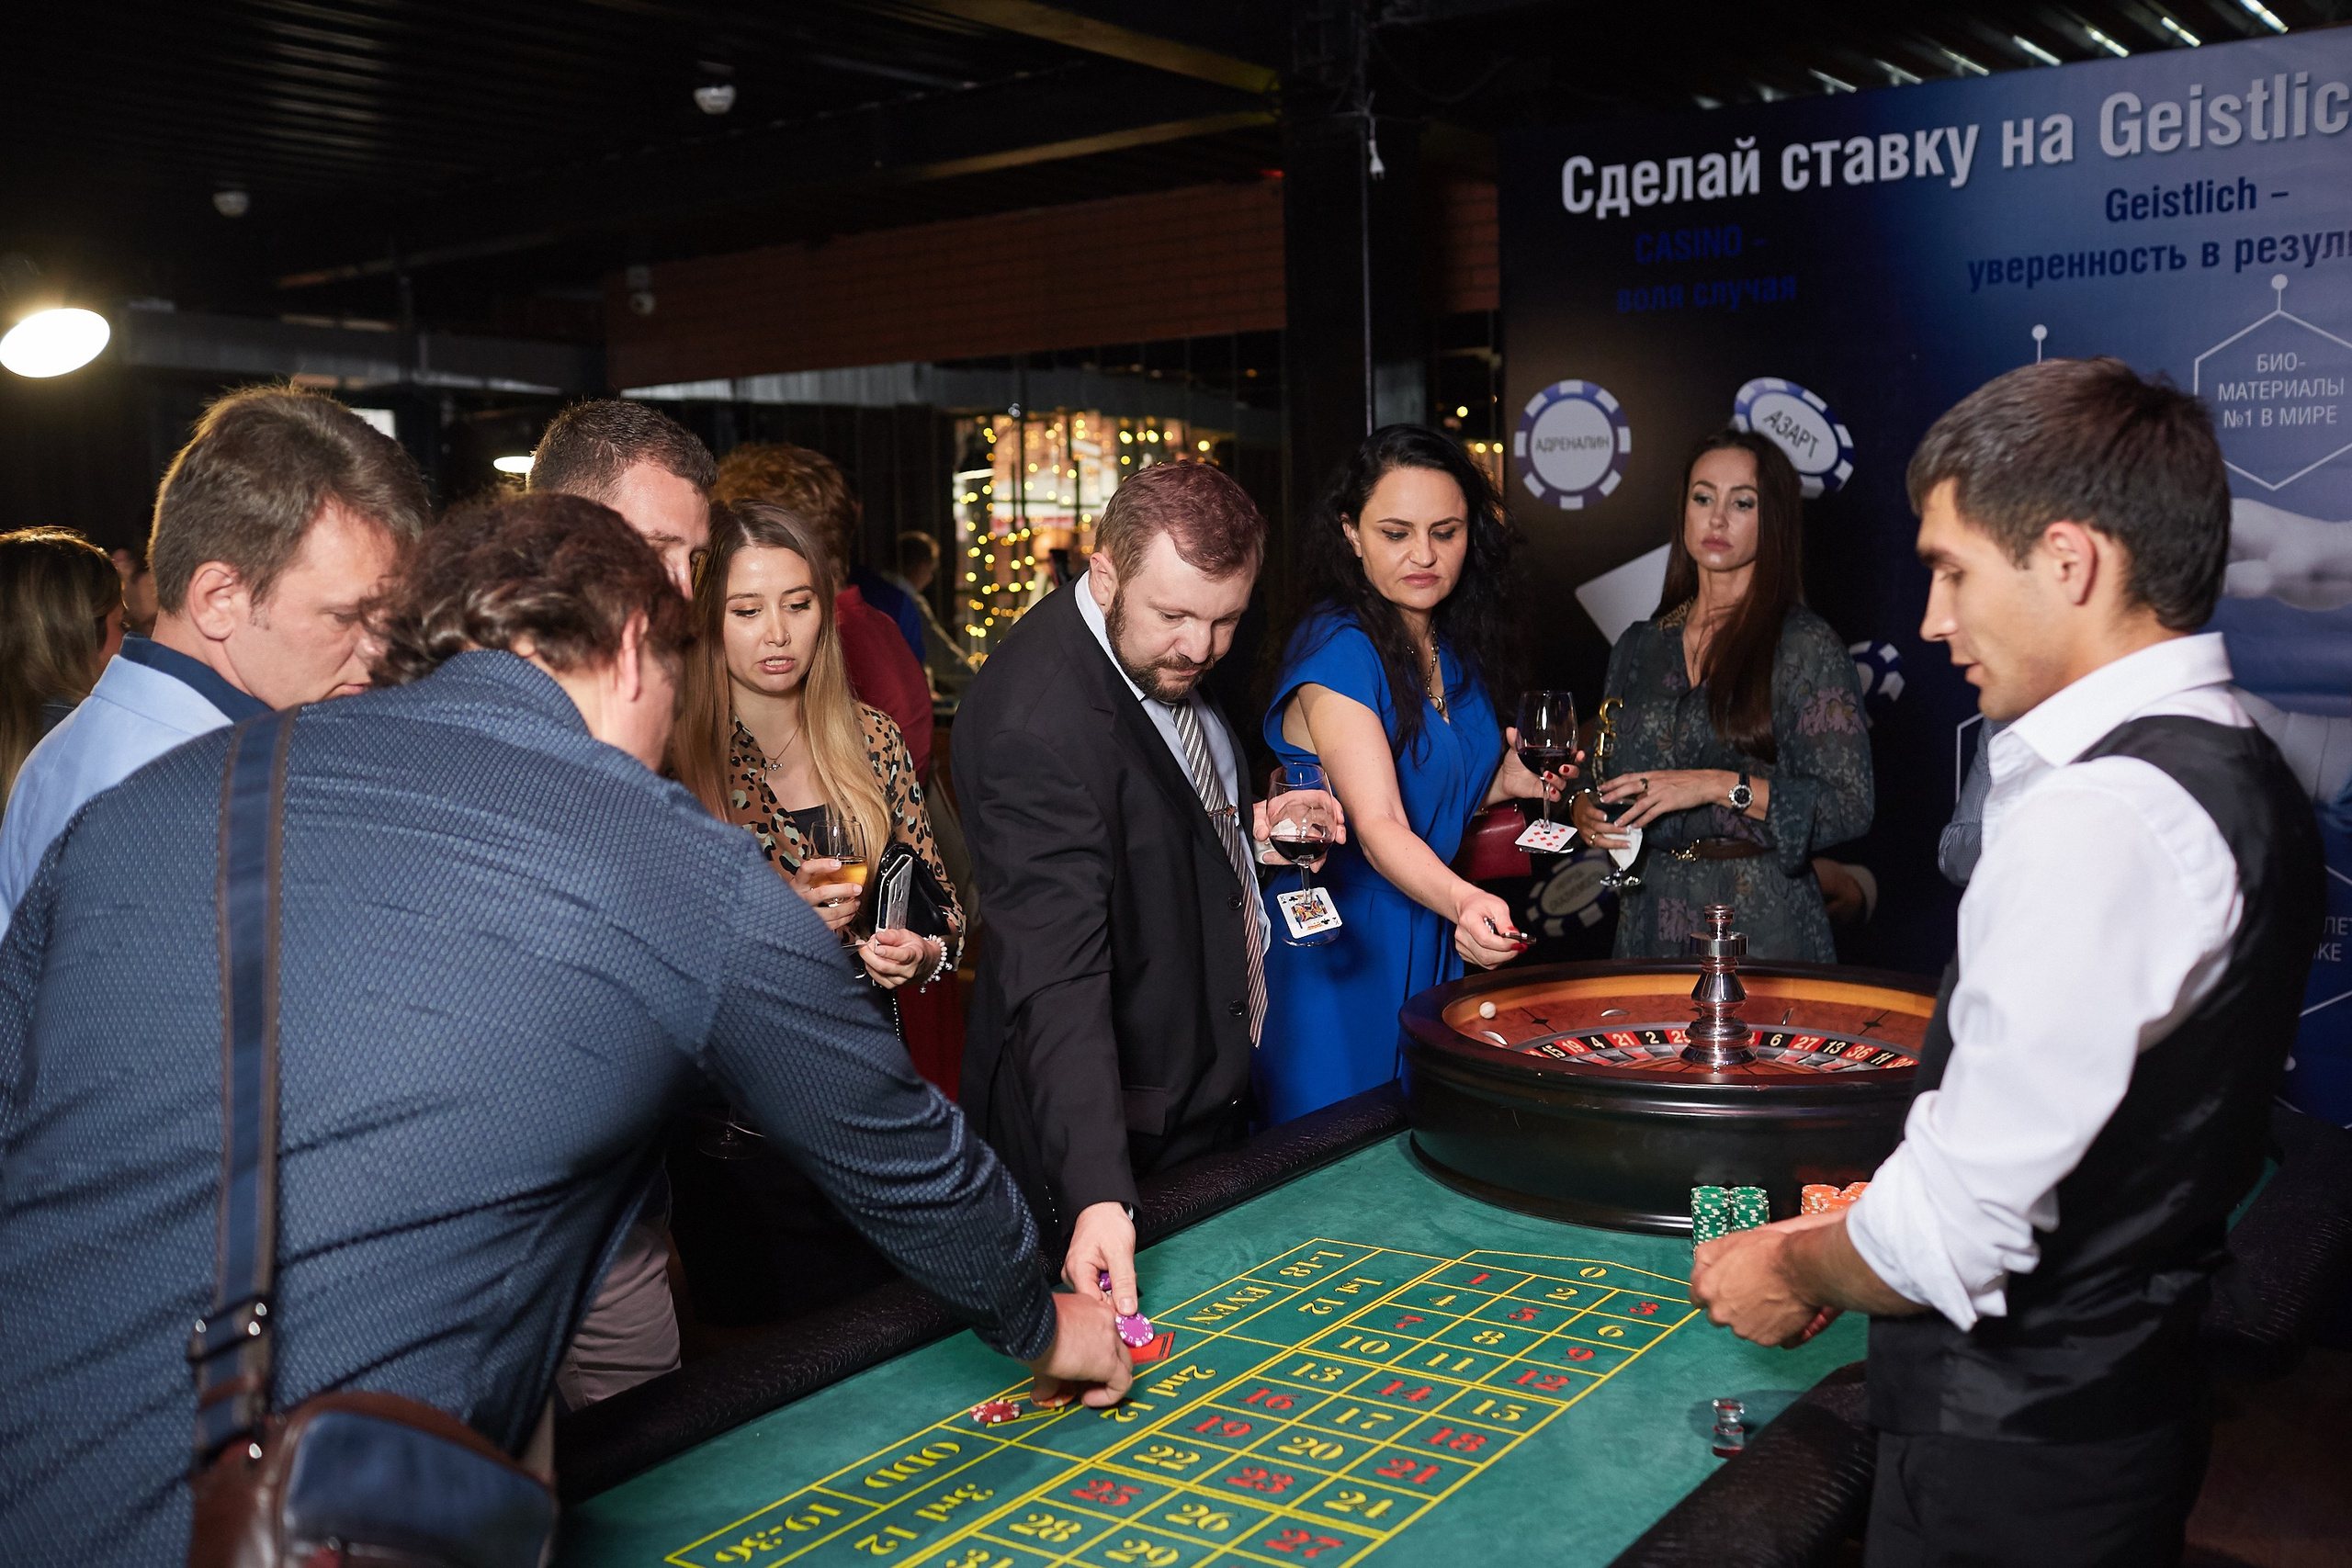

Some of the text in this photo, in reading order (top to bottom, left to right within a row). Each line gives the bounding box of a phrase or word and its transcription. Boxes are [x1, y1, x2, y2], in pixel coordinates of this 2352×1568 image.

[1562, 71, 2350, 220] Сделай ставку на Geistlic
[2106, 176, 2257, 222] Geistlich
[1635, 225, 1744, 265] CASINO
[1968, 243, 2187, 293] уверенность
[2202, 240, 2221, 268] в
[1617, 275, 1797, 313] воля случая
[2257, 352, 2306, 374] БИО-
[2218, 378, 2345, 401] МАТЕРИАЛЫ
[2223, 405, 2337, 429] №1 В МИРЕ
[1762, 410, 1820, 459] АЗАРТ
[1562, 1040, 1586, 1054] 19
[1590, 1036, 1605, 1049] 4
[1612, 1033, 1634, 1046] 21
[1645, 1032, 1659, 1044] 2
[1770, 1033, 1782, 1046] 6
[1797, 1036, 1820, 1051] 27
[1823, 1040, 1847, 1055] 13
[1847, 1045, 1873, 1060] 36
[1279, 1249, 1347, 1278] 1-18
[1578, 1267, 1607, 1279] 0
[1468, 1272, 1492, 1286] 1
[1183, 1285, 1275, 1325] EVEN
[1297, 1276, 1385, 1315] 1st 12
[1429, 1293, 1458, 1308] 4
[1545, 1287, 1579, 1301] 2
[1394, 1314, 1426, 1329] 7
[1508, 1308, 1543, 1323] 5
[1628, 1302, 1660, 1316] 3
[1471, 1330, 1507, 1346] 8
[1597, 1324, 1630, 1338] 6
[1335, 1335, 1392, 1355] 10
[1565, 1347, 1596, 1362] 9
[1288, 1361, 1344, 1382] 13
[1422, 1352, 1476, 1373] 11
[1099, 1365, 1217, 1423] 2nd 12
[1374, 1380, 1434, 1403] 14
[1512, 1369, 1571, 1393] 12
[1238, 1386, 1297, 1411] 16
[1471, 1398, 1529, 1423] 15
[1190, 1415, 1253, 1438] 19
[1332, 1407, 1395, 1430] 17
[1277, 1436, 1345, 1461] 20
[1423, 1426, 1488, 1453] 18
[864, 1442, 960, 1488] ODD
[1133, 1445, 1202, 1472] 22
[1374, 1457, 1442, 1485] 21
[1069, 1479, 1143, 1506] 25
[1225, 1467, 1295, 1495] 23
[1164, 1504, 1238, 1532] 26
[1323, 1490, 1395, 1520] 24
[714, 1502, 842, 1563] 19-36
[854, 1483, 994, 1555] 3rd 12
[1008, 1513, 1083, 1543] 28
[1103, 1539, 1181, 1567] 29
[1263, 1529, 1344, 1559] 27
